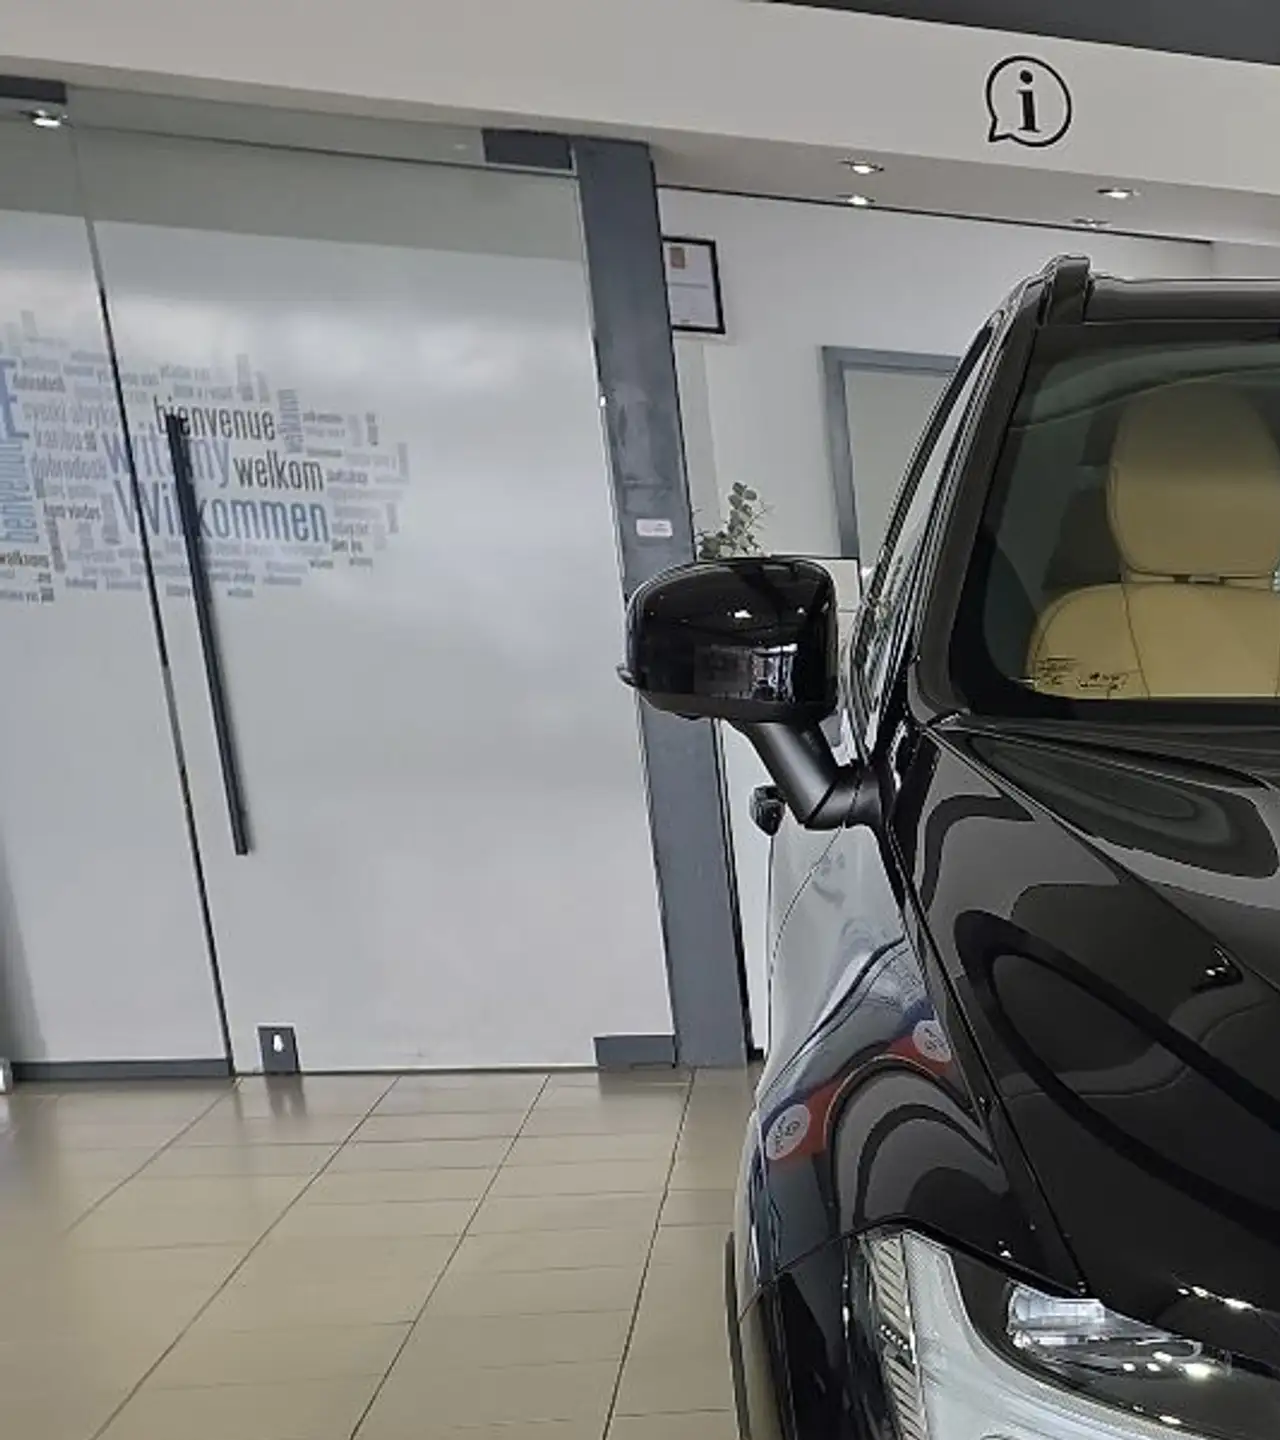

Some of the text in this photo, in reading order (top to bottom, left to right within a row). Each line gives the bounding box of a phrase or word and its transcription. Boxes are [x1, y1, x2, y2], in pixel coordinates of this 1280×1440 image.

[101, 423, 230, 487] witmy
[233, 449, 325, 492] welkom
[112, 480, 330, 543] Wilkommen
